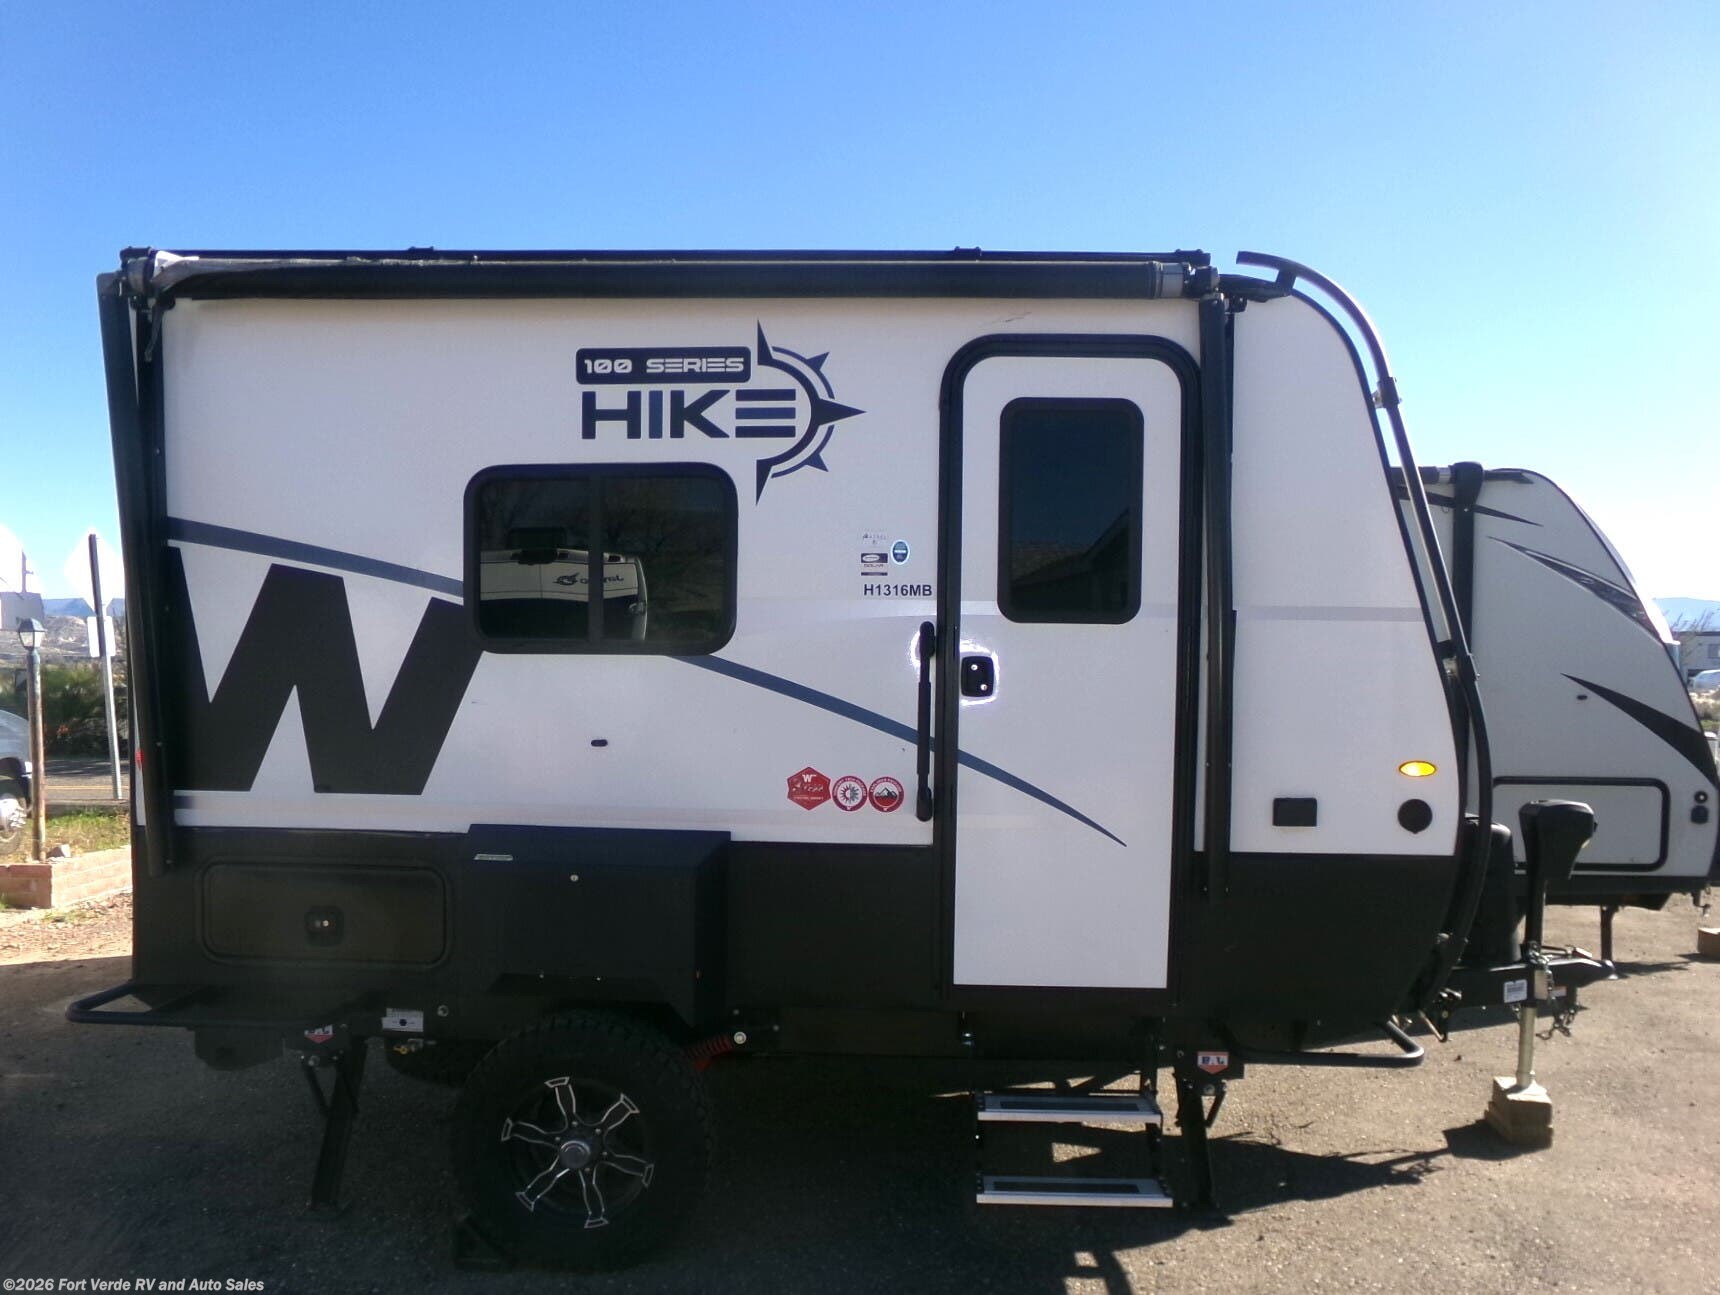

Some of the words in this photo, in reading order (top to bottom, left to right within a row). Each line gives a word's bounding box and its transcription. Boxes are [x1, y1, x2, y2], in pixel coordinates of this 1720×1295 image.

[584, 359, 632, 374] 100
[646, 357, 744, 373] SERIES
[581, 389, 796, 440] HIKE
[863, 583, 933, 597] H1316MB
